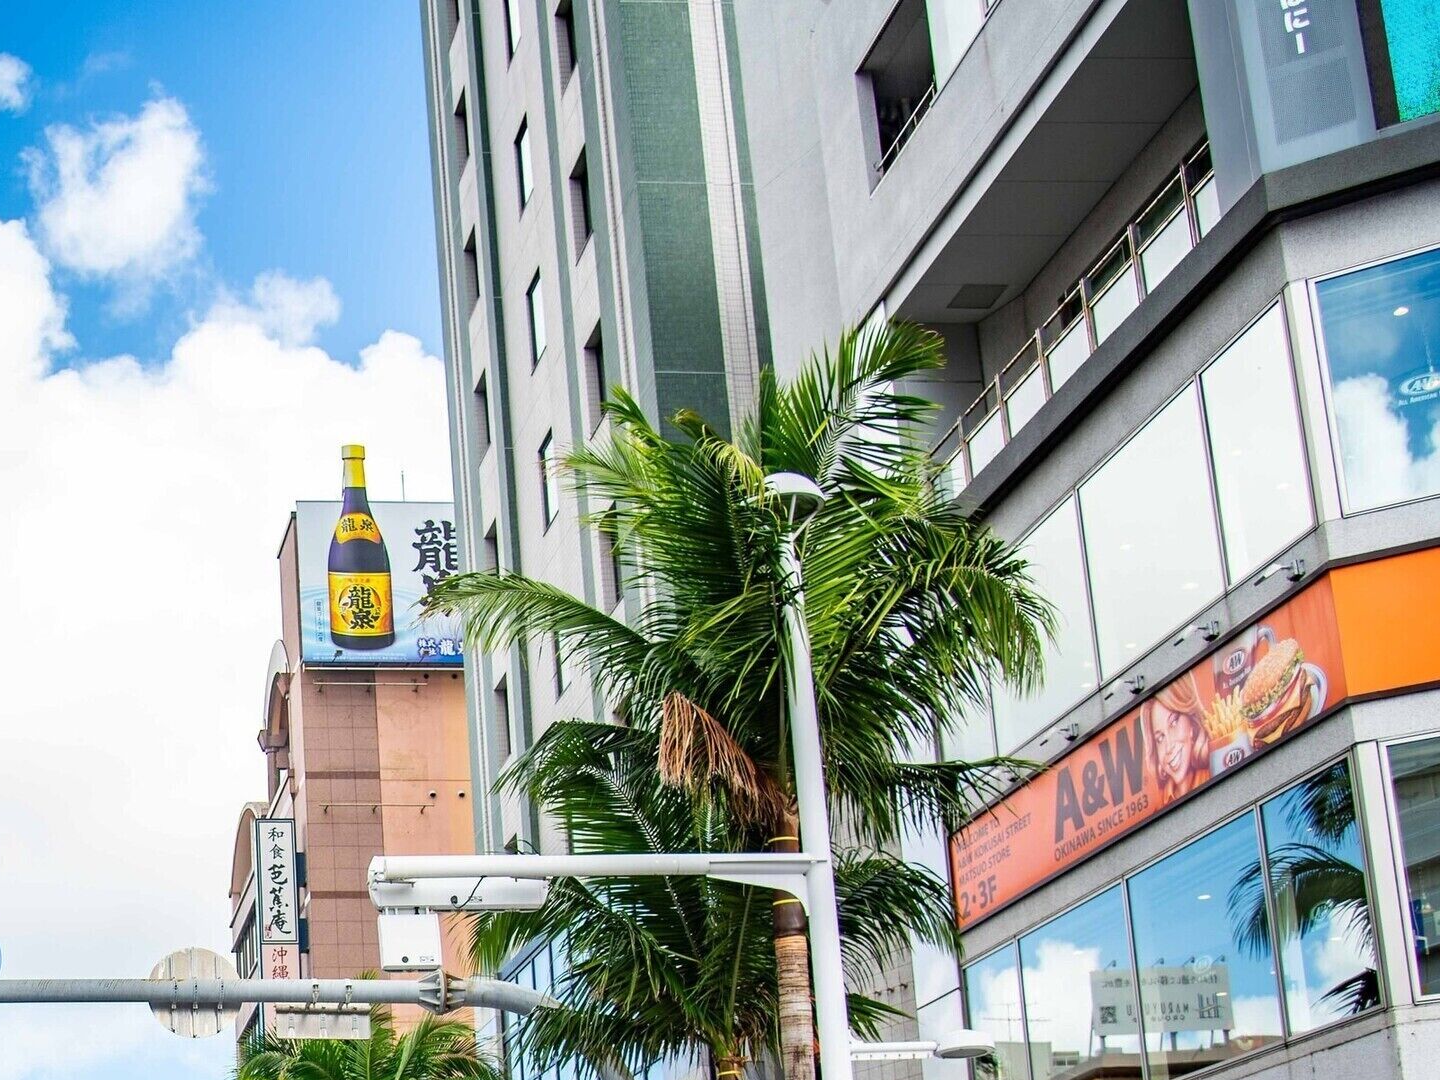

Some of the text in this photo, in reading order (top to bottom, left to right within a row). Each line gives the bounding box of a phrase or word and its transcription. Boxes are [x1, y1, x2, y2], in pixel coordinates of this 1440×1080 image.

[341, 517, 375, 533] 龍泉
[412, 519, 460, 612] 龍
[347, 586, 377, 630] 龍泉
[1054, 716, 1144, 844] A&W
[268, 827, 285, 859] 和食
[1005, 812, 1032, 840] STREET
[1054, 794, 1149, 862] OKINAWA SINCE 1963
[988, 845, 1012, 869] STORE
